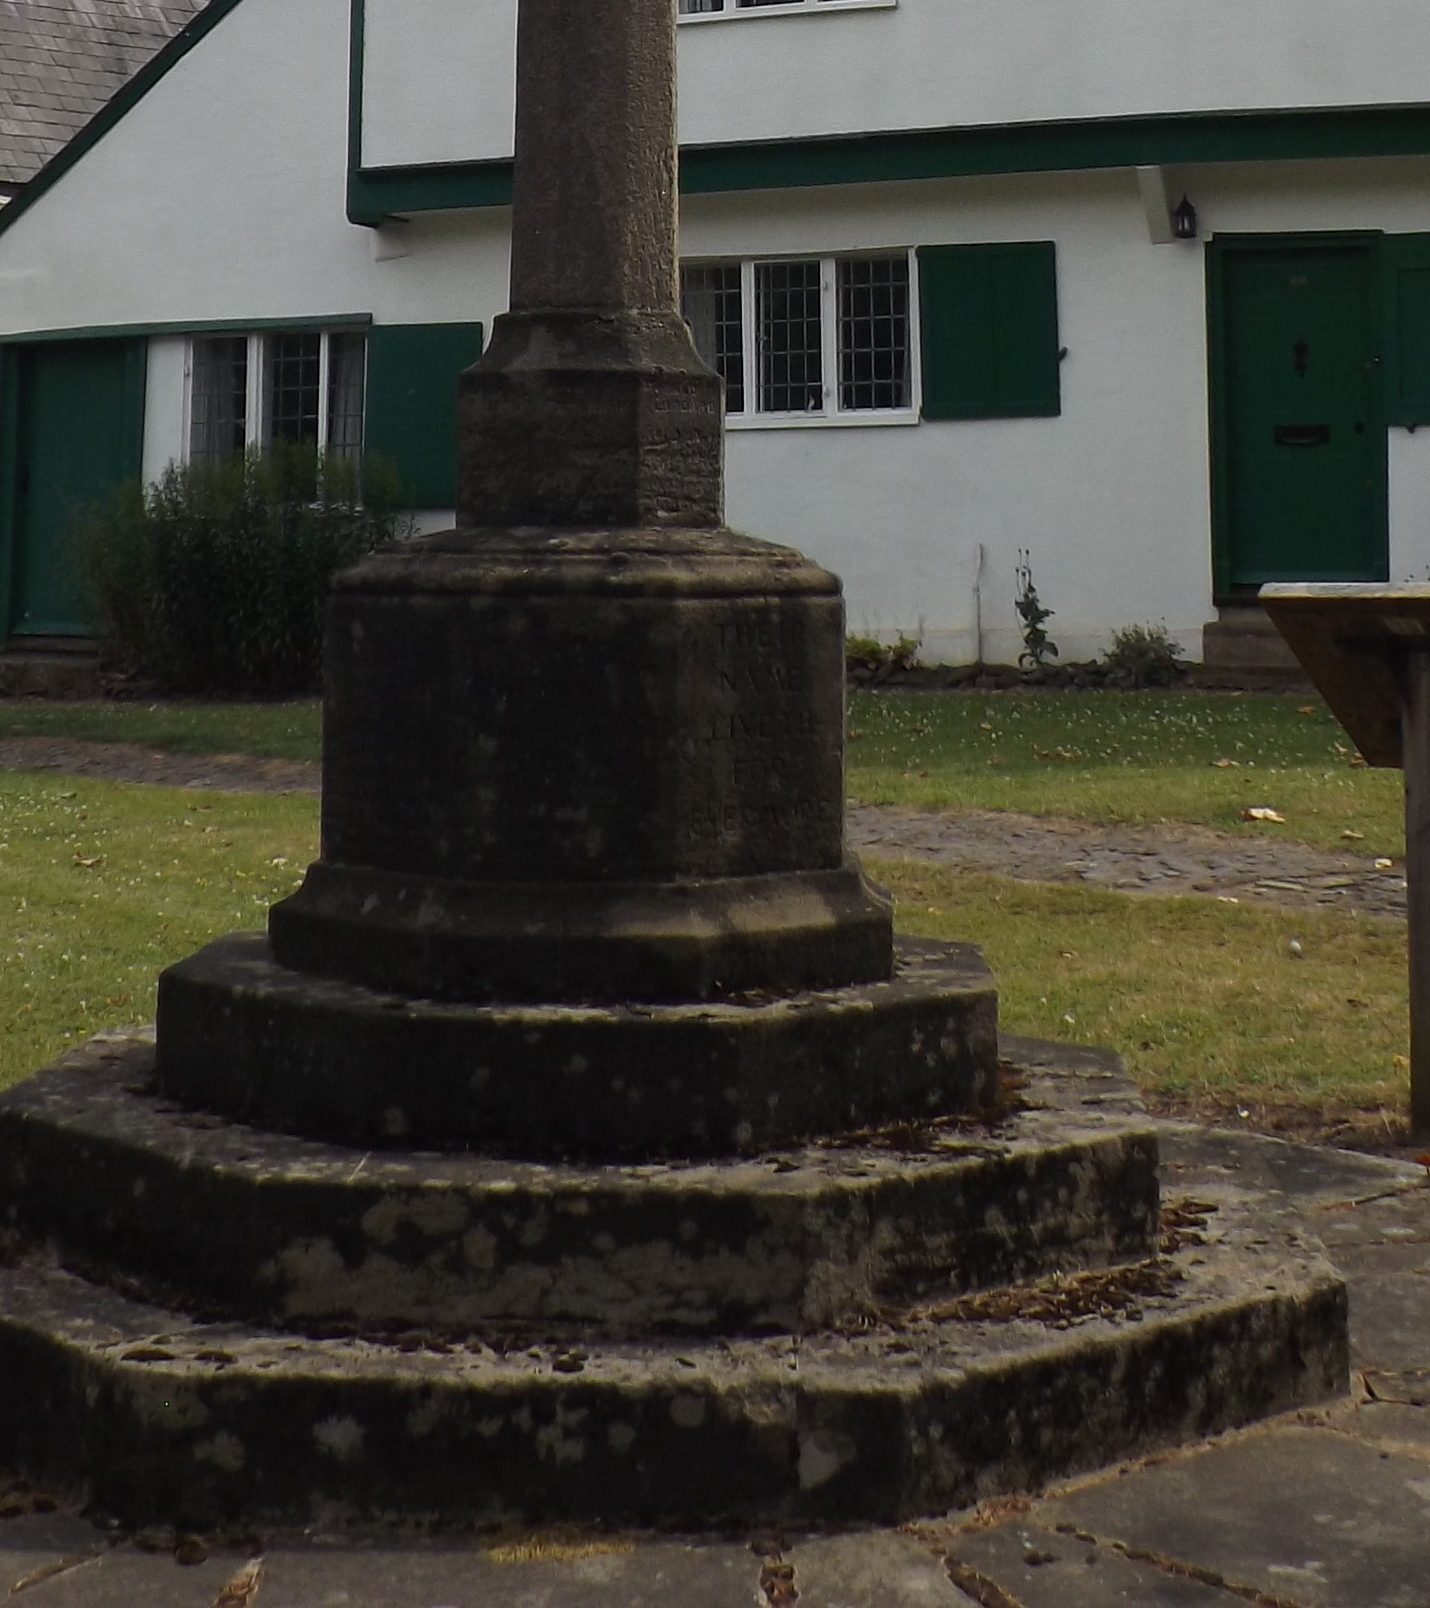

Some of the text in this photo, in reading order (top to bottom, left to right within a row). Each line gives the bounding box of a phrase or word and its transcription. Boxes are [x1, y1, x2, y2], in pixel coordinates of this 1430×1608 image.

[716, 621, 806, 650] THEIR
[720, 667, 804, 695] NAME
[710, 710, 819, 740] LIVETH
[733, 755, 789, 789] FOR
[687, 798, 833, 841] EVERMORE
